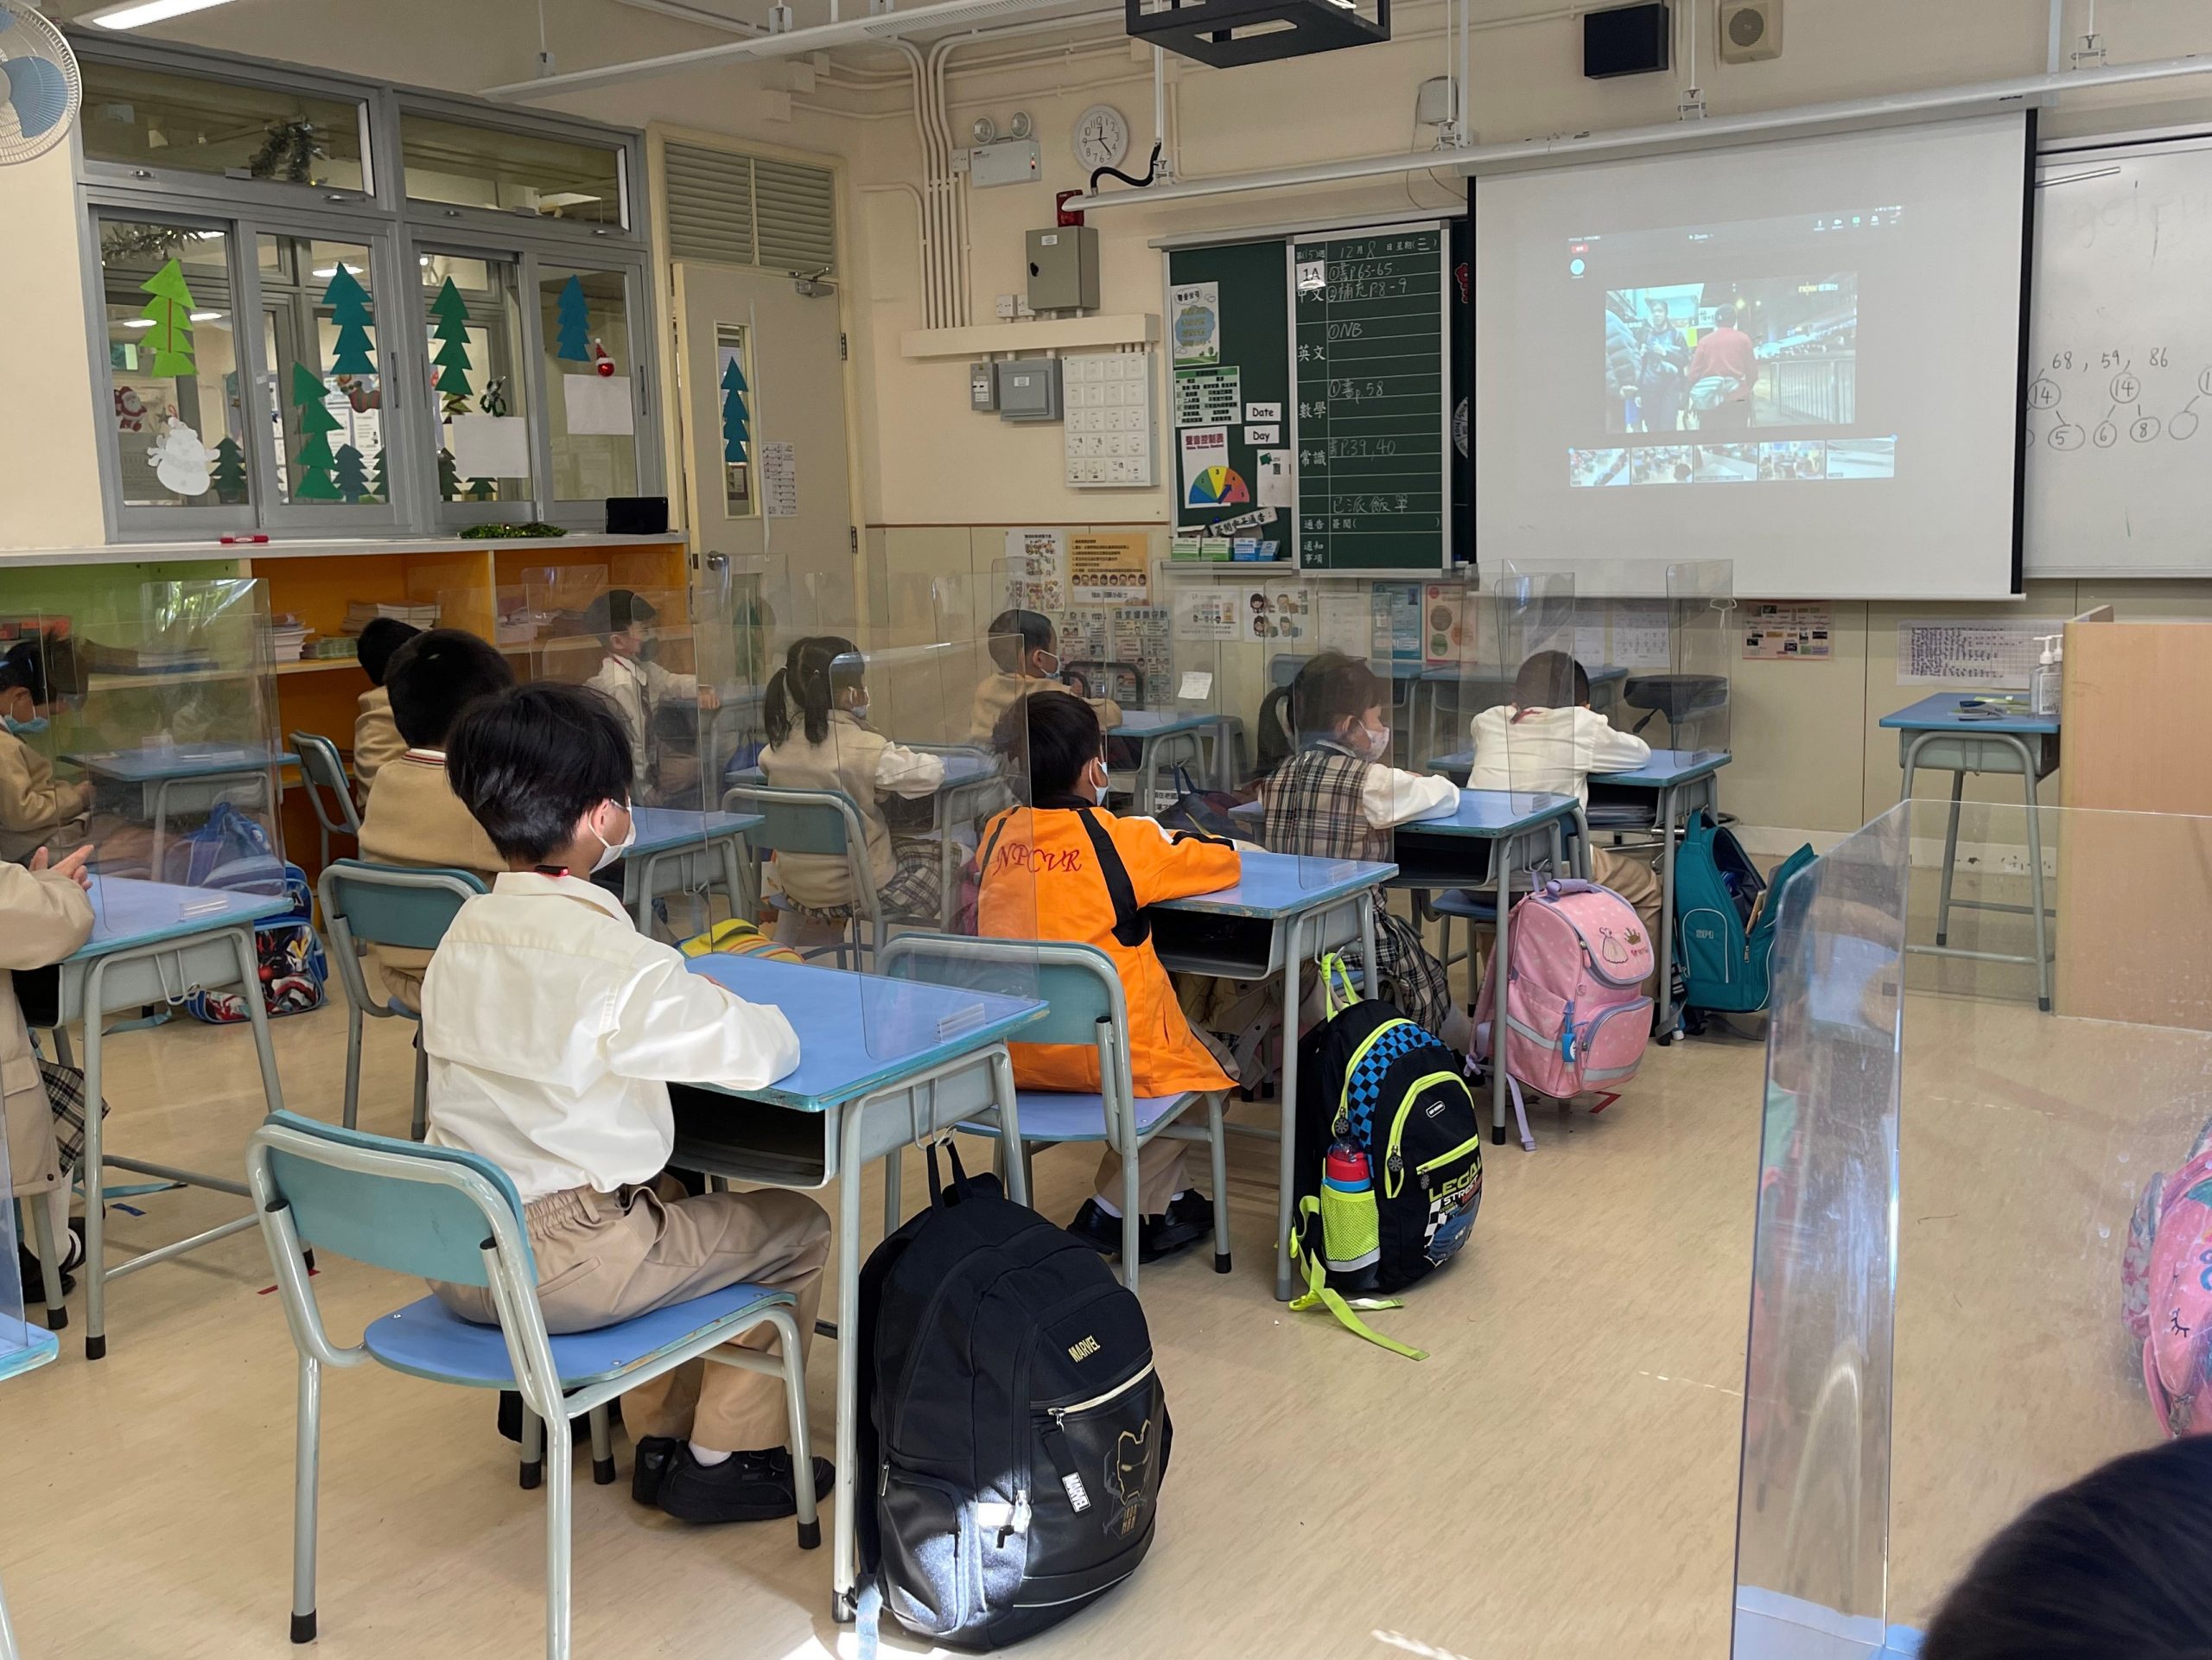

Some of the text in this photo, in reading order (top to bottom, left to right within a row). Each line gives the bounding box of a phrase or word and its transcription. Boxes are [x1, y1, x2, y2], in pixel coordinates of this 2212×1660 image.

[1303, 268, 1320, 282] 1A
[1298, 289, 1324, 302] 中文
[1298, 344, 1326, 362] 英文
[2150, 347, 2169, 368] 86
[2034, 385, 2054, 405] 14
[2115, 379, 2134, 398] 14
[1253, 408, 1274, 417] Date
[1300, 401, 1326, 419] 數學
[1253, 431, 1270, 442] Day
[2055, 430, 2070, 445] 5
[2100, 427, 2107, 442] 6
[2139, 423, 2148, 438] 8
[1300, 449, 1327, 467] 常識
[1304, 518, 1325, 531] 通告
[1068, 1335, 1101, 1364] MARVEL
[1062, 1473, 1090, 1512] MARVEL
